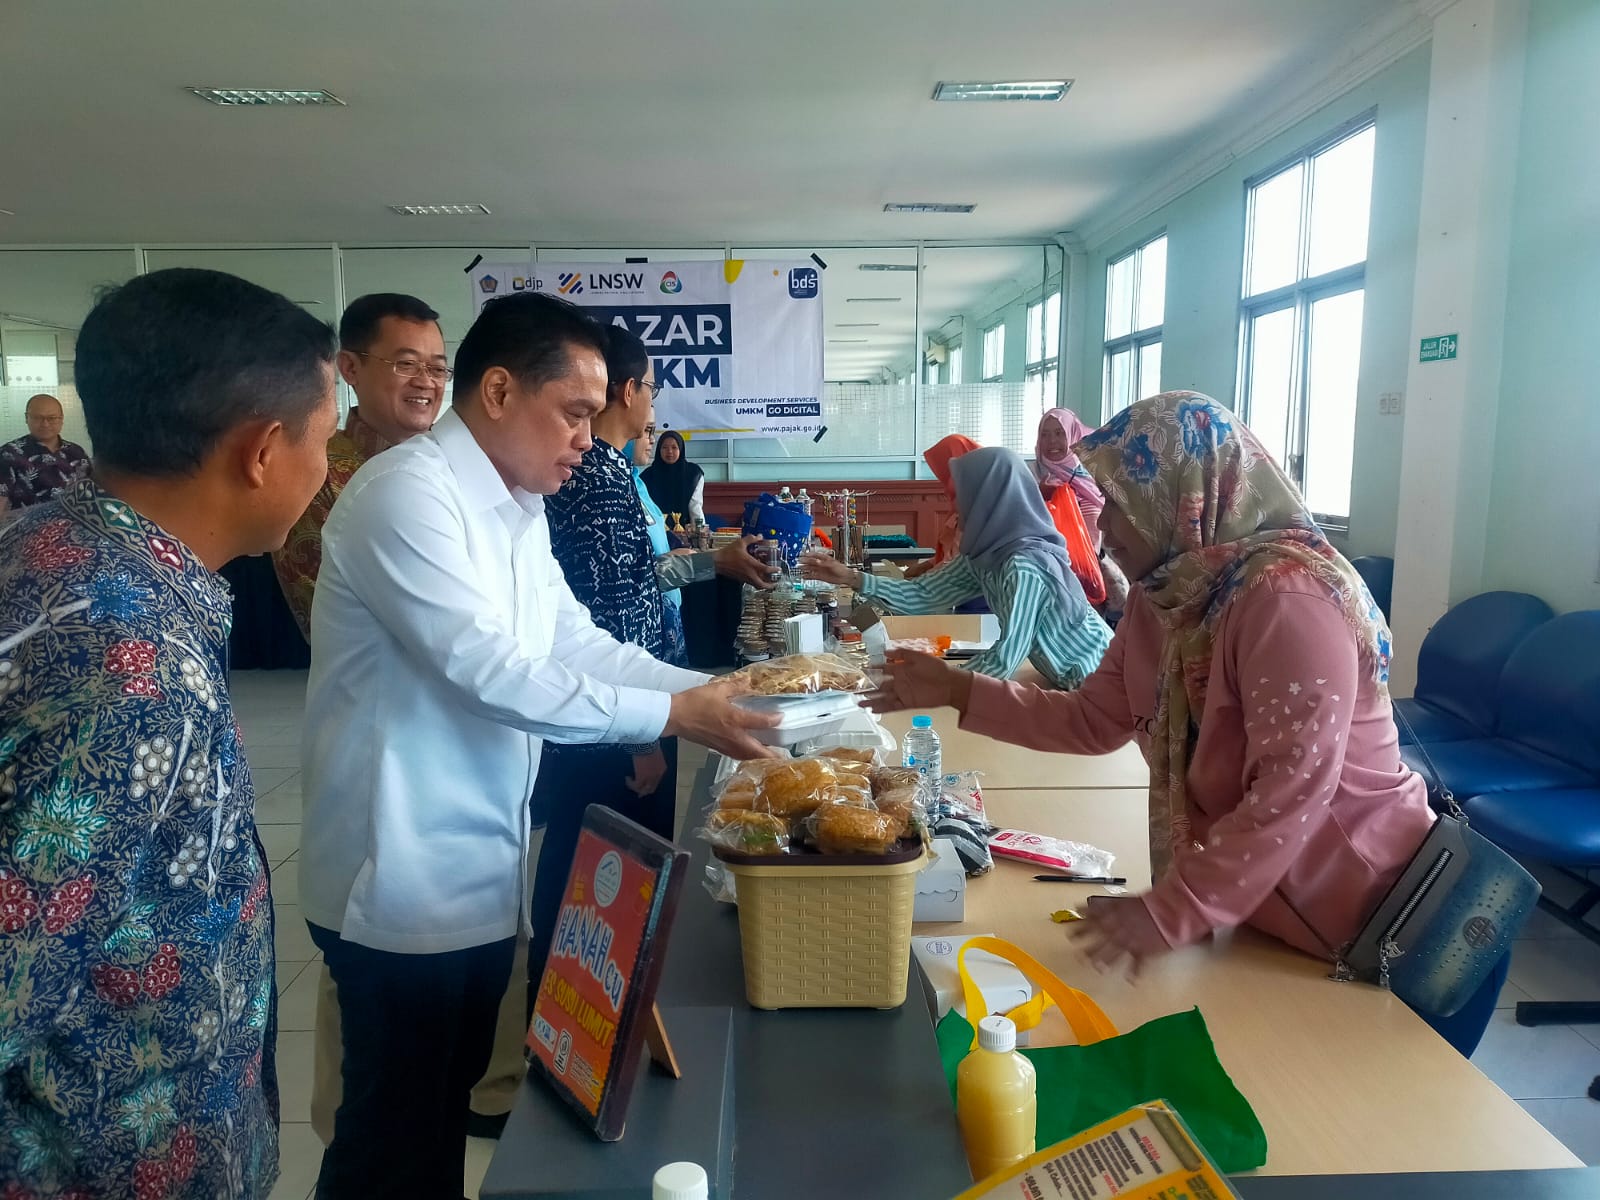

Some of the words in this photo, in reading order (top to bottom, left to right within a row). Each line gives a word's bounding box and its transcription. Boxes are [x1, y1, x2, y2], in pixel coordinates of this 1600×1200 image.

[525, 277, 543, 291] djp
[589, 273, 644, 289] LNSW
[791, 269, 818, 289] bds
[611, 314, 724, 346] ZAR
[653, 358, 721, 388] KM
[735, 407, 764, 415] UMKM
[783, 406, 818, 414] DIGITAL
[576, 999, 615, 1048] LUMUT
